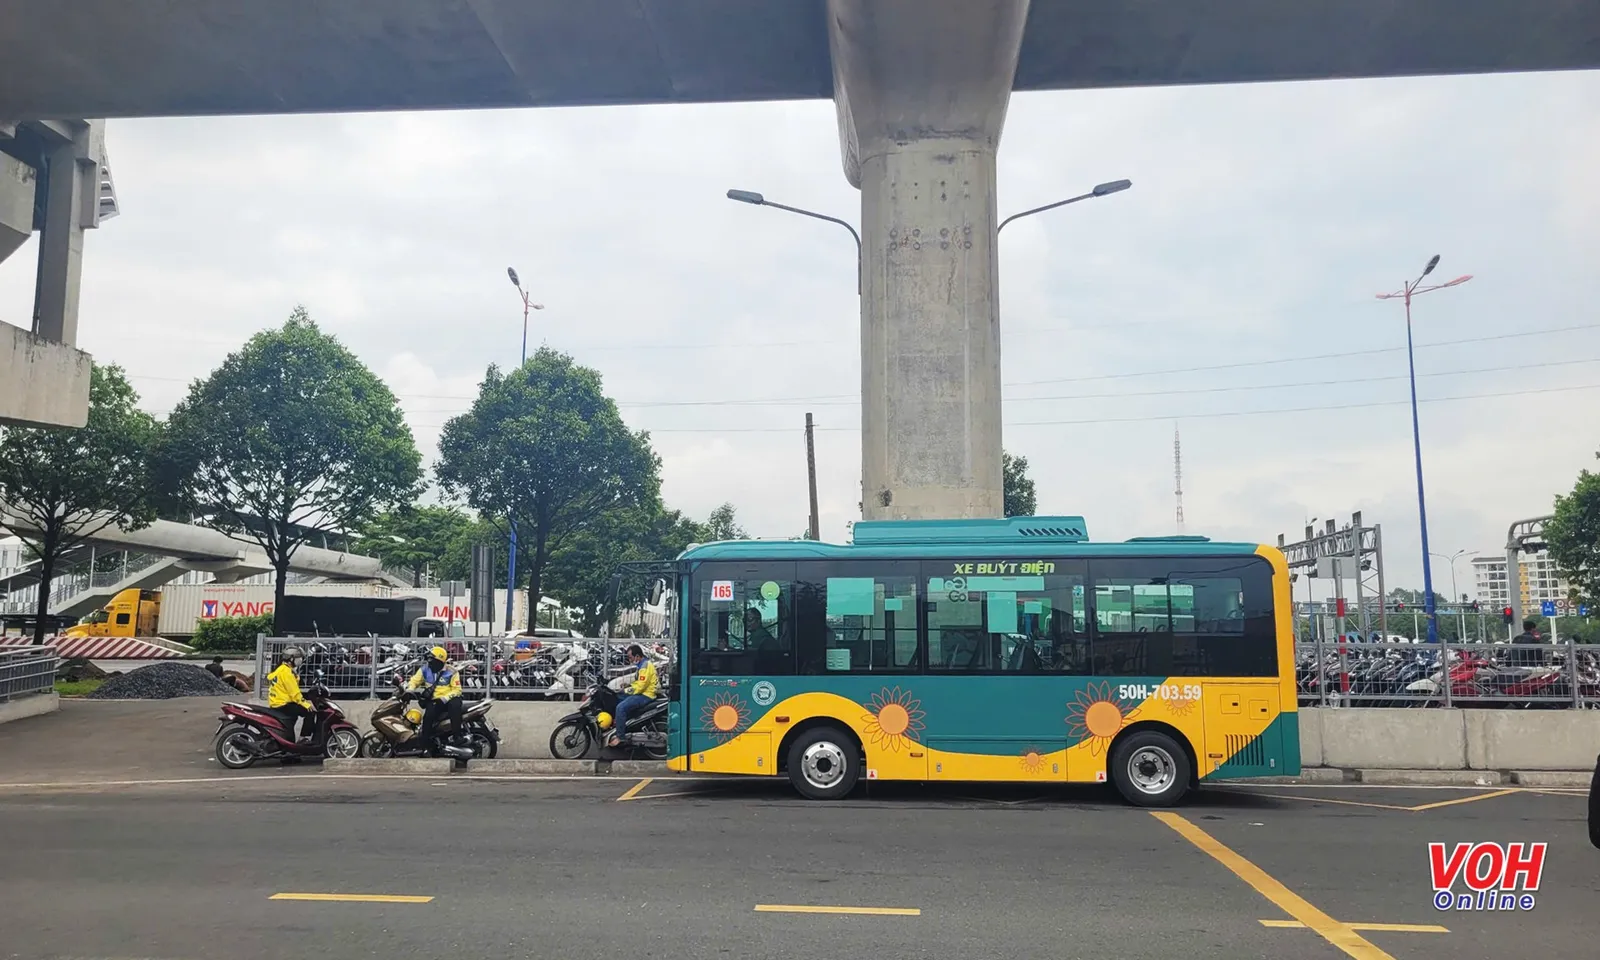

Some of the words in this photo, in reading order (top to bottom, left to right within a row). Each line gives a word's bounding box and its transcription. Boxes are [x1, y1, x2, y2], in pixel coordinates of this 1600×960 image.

[953, 563, 974, 574] XE
[976, 560, 1018, 574] BUÝT
[713, 585, 731, 598] 165
[222, 601, 273, 616] YANG
[433, 606, 472, 619] MN
[1119, 684, 1202, 700] 50H-703.59
